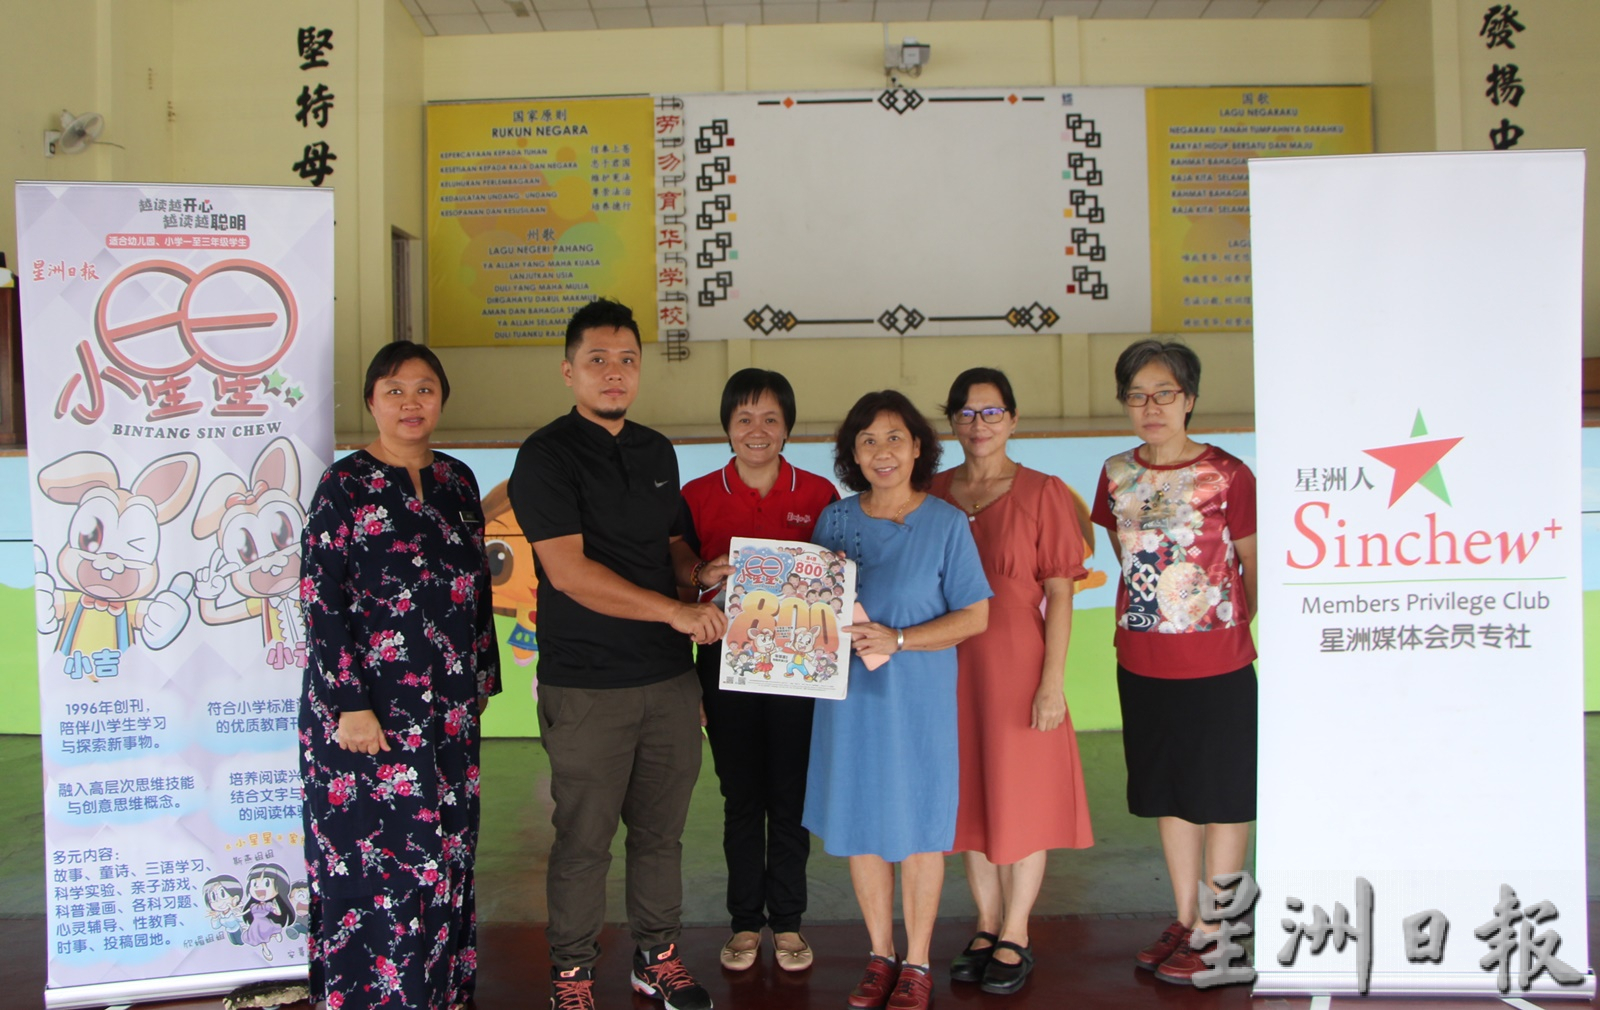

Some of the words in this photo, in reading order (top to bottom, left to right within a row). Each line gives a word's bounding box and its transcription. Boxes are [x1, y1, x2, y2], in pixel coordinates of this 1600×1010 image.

[1220, 108, 1244, 117] LAGU
[1247, 108, 1298, 117] NEGARAKU
[492, 127, 532, 138] RUKUN
[536, 125, 588, 136] NEGARA
[1169, 126, 1216, 135] NEGARAKU
[1219, 125, 1248, 134] TANAH
[440, 151, 492, 160] KEPERCAYAAN
[494, 150, 522, 158] KEPADA
[547, 162, 578, 170] NEGARA
[483, 178, 541, 186] PERLEMBAGAAN
[138, 198, 214, 213] 越读越开心
[162, 214, 247, 231] 越读越聪明
[527, 228, 556, 241] 州歌
[489, 246, 514, 255] LAGU
[517, 245, 550, 254] NEGERI
[553, 244, 594, 253] PAHANG
[496, 261, 520, 269] ALLAH
[522, 260, 545, 268] YANG
[548, 259, 572, 267] MAHA
[574, 259, 600, 267] KUASA
[509, 272, 554, 280] LANJUTKAN
[556, 271, 573, 279] USIA
[513, 284, 536, 292] YANG
[539, 283, 563, 291] MAHA
[486, 296, 533, 304] DIRGAHAYU
[482, 308, 506, 316] AMAN
[508, 307, 526, 315] DAN
[528, 307, 565, 315] BAHAGIA
[510, 319, 534, 327] ALLAH
[495, 331, 511, 339] DULI
[112, 423, 191, 439] BINTANG
[197, 423, 226, 438] SIN
[232, 421, 282, 437] CHEW
[1294, 467, 1375, 492] 星洲人
[795, 562, 823, 578] 800
[1301, 594, 1400, 615] Members
[1407, 592, 1496, 616] Privilege
[1503, 591, 1550, 610] Club
[726, 590, 839, 653] 800
[1320, 623, 1532, 652] 星洲媒体会员专社
[63, 649, 121, 680] 小吉
[60, 716, 166, 736] 陪伴小学生学习
[61, 735, 160, 754] 与探索新事物。
[58, 775, 195, 798] 融入高层次思维技能
[67, 795, 180, 815] 与创意思维概念。
[57, 933, 171, 955] 时事、投稿园地。
